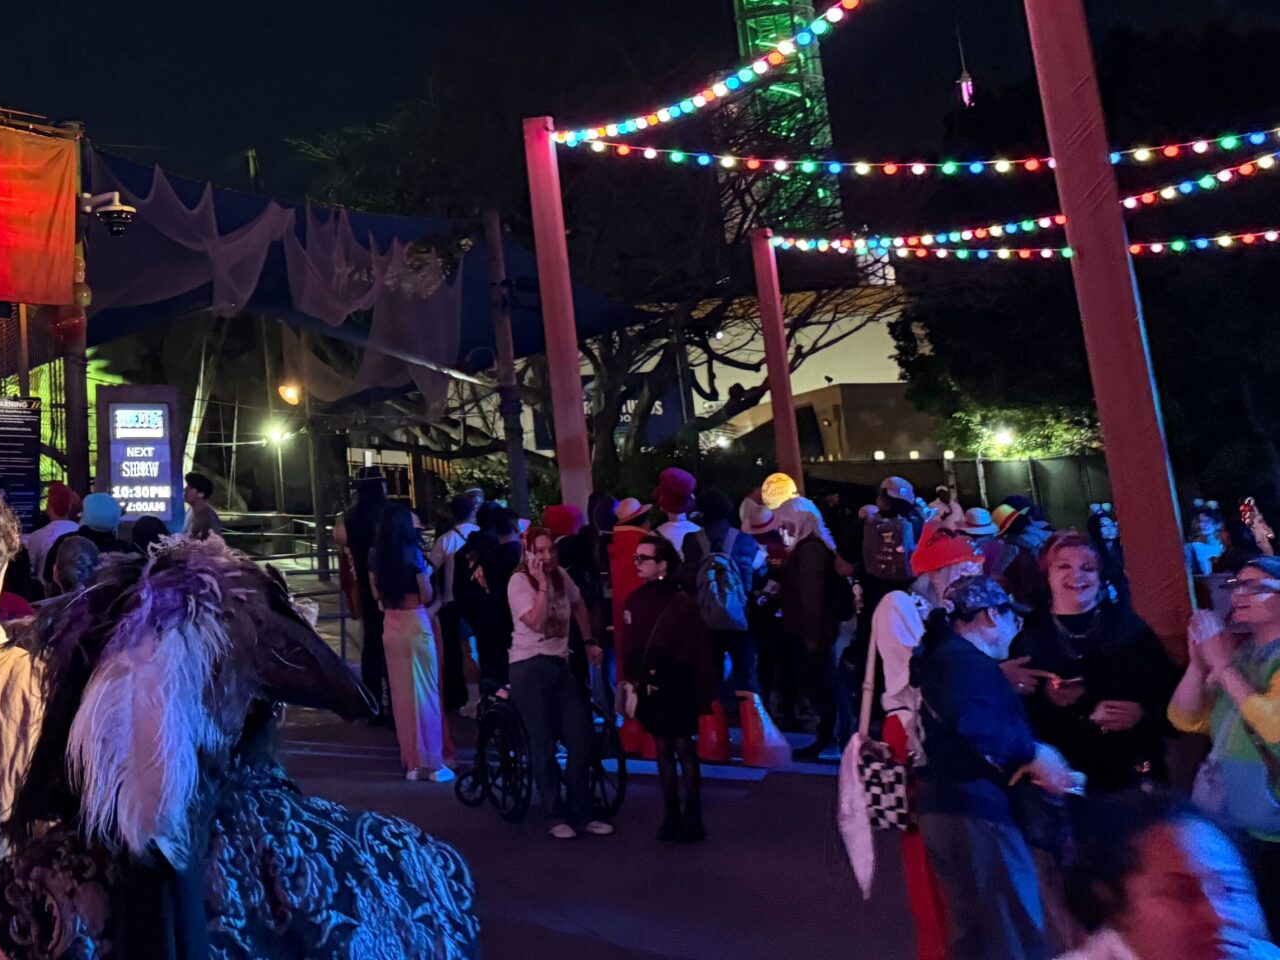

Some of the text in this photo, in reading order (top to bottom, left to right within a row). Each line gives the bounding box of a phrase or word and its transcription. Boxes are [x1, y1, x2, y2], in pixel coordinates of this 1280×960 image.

[126, 446, 155, 457] NEXT
[122, 461, 159, 477] SHOW
[112, 485, 172, 498] 10:30PM
